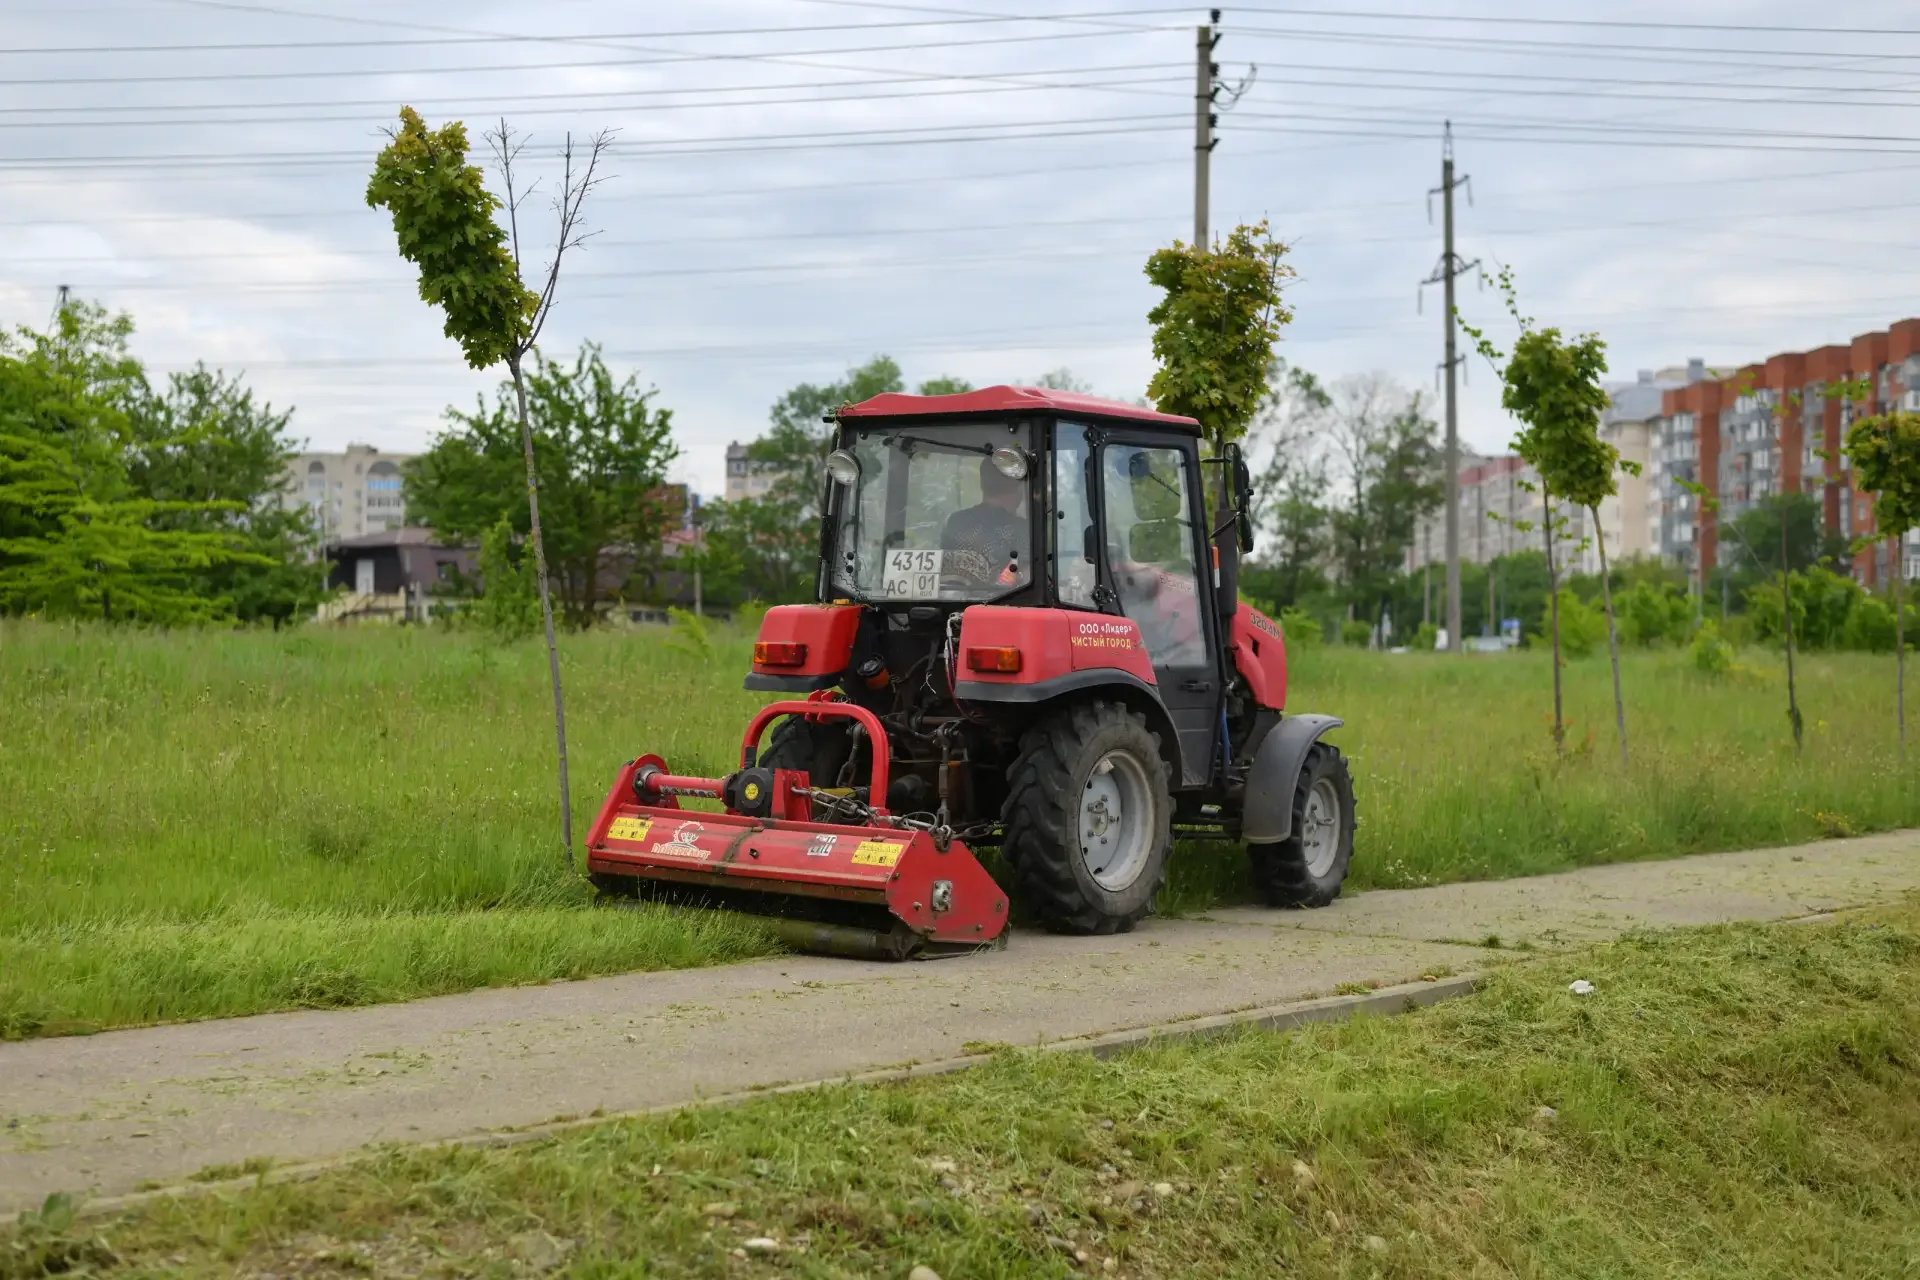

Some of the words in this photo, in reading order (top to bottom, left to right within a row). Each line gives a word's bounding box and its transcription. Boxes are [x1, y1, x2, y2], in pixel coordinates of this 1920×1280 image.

[892, 551, 935, 572] 4315
[918, 574, 935, 591] 01
[1079, 623, 1099, 634] ООО
[1071, 634, 1105, 648] ЧИСТЫЙ
[1106, 638, 1132, 650] ГОРОД
